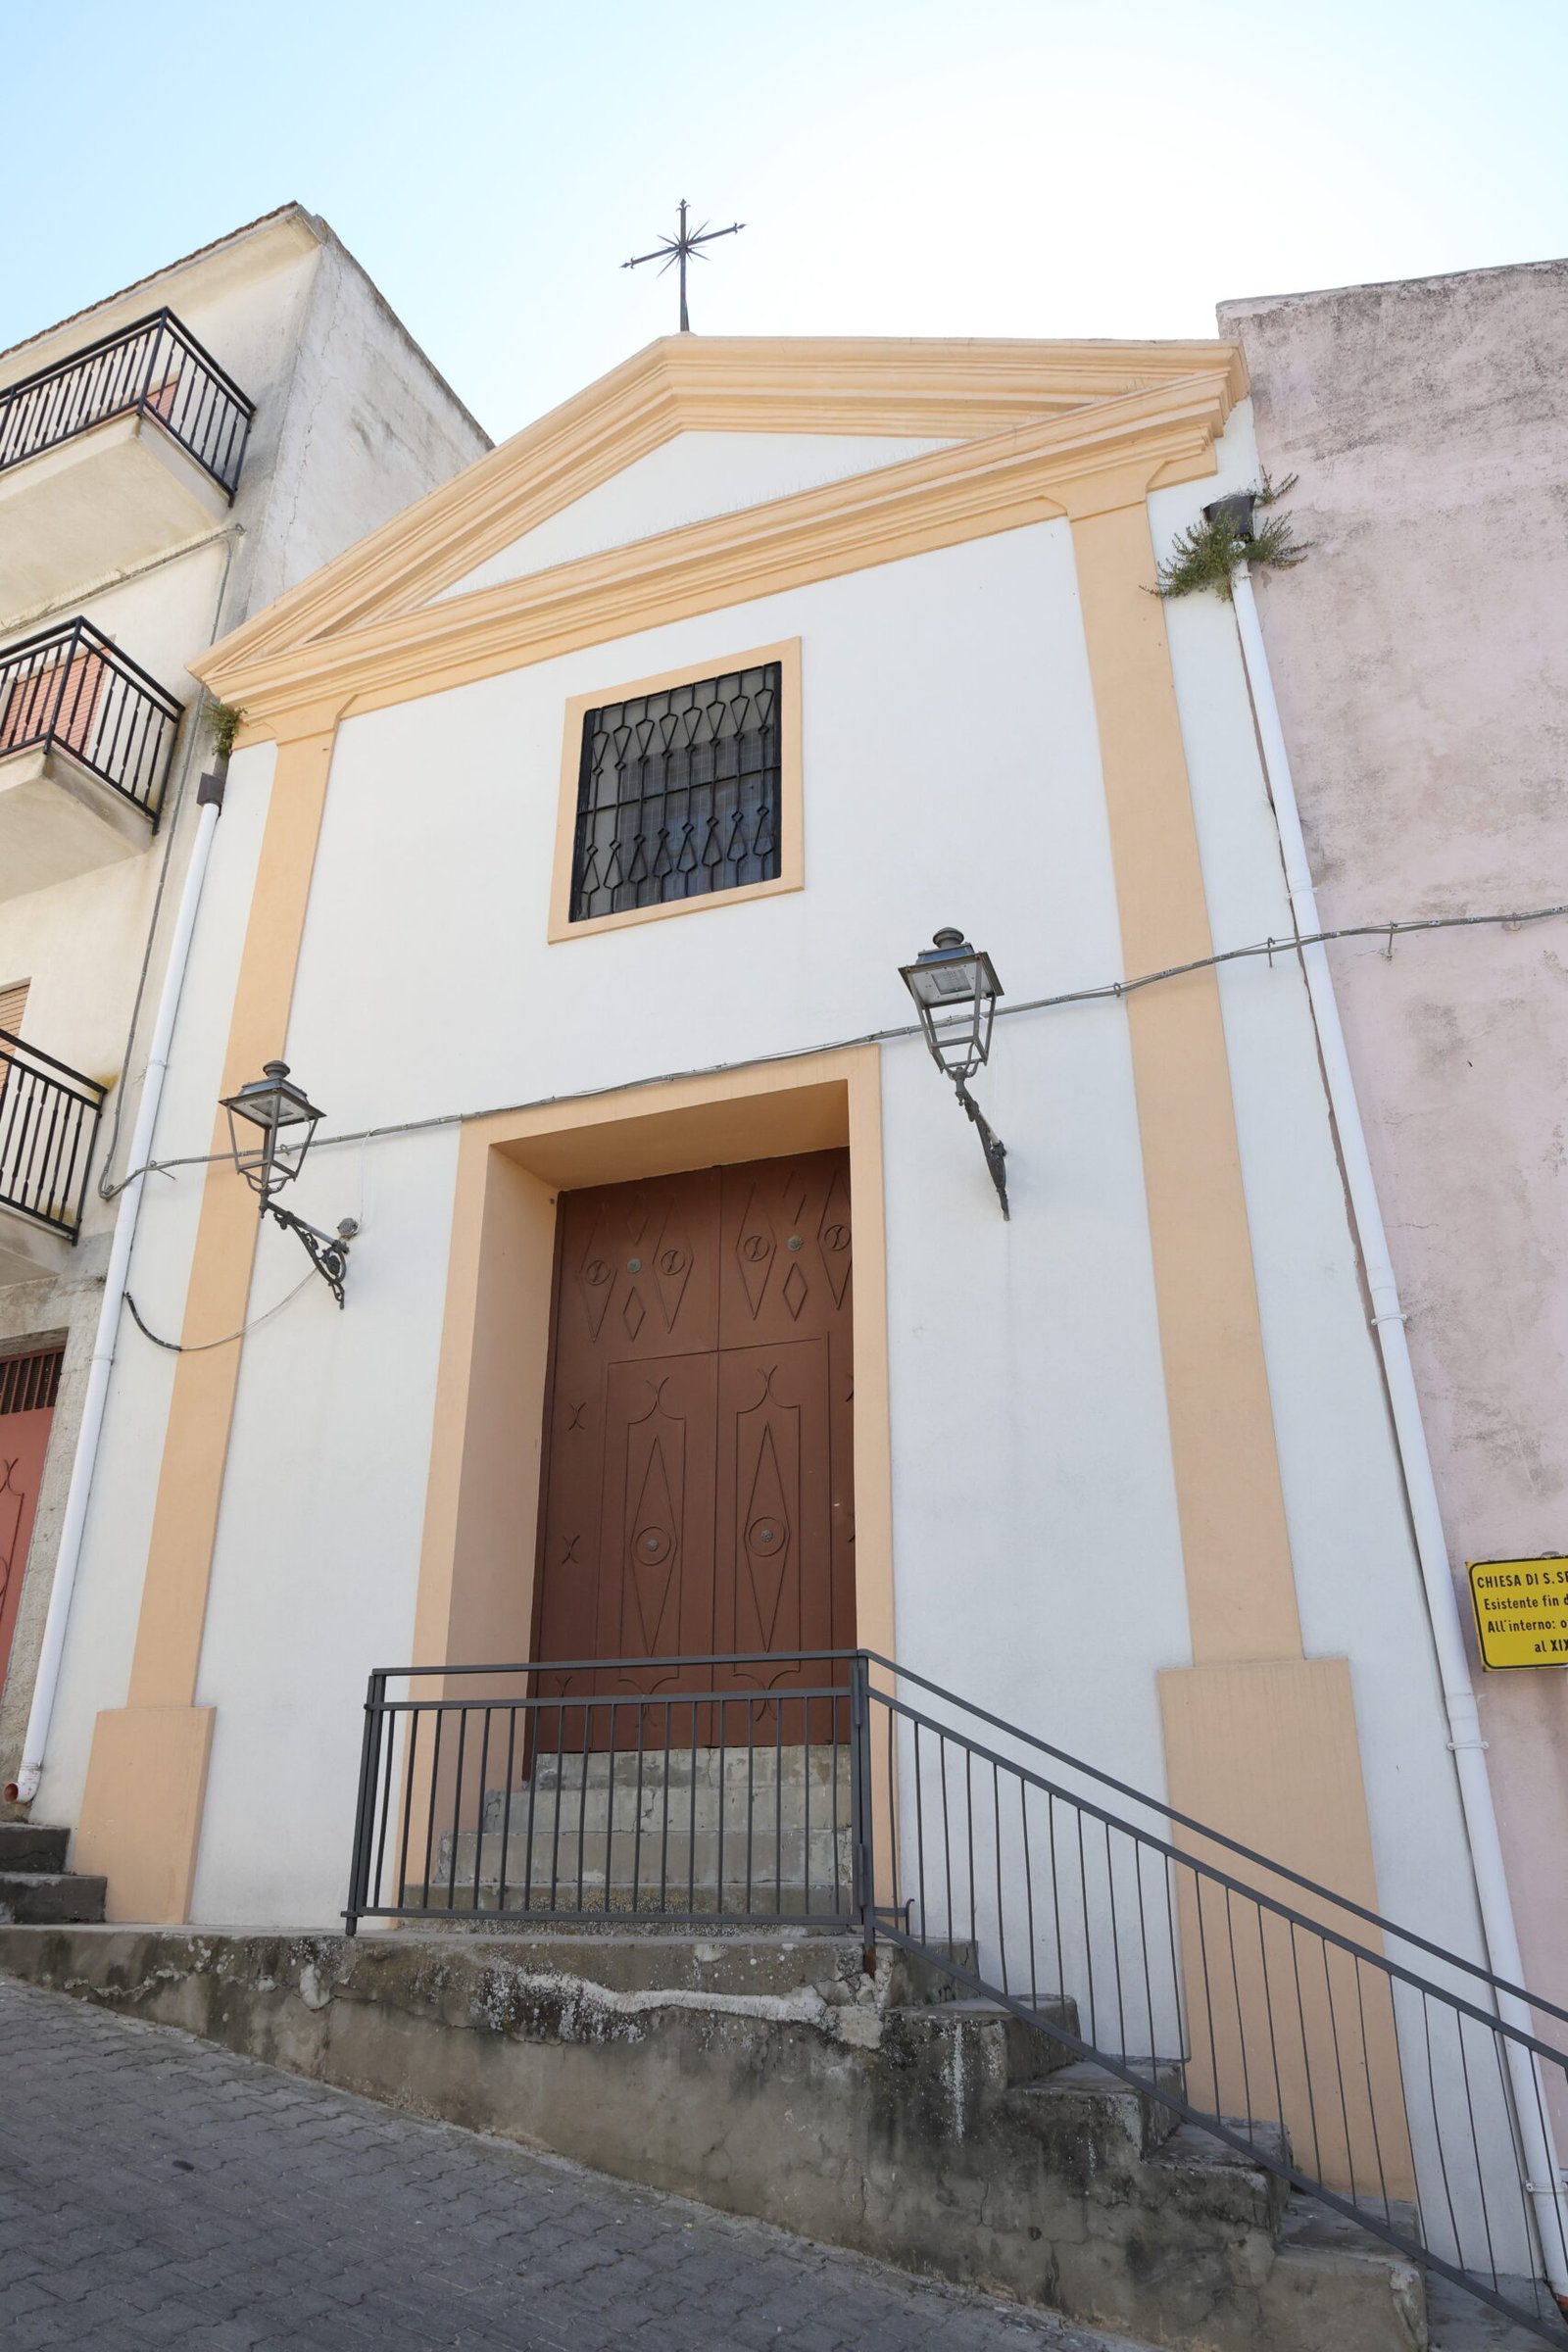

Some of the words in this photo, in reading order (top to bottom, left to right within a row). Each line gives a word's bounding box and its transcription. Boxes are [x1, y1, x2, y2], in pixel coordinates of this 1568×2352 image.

[1477, 1574, 1522, 1588] CHIESA
[1526, 1573, 1539, 1586] DI
[1484, 1596, 1539, 1610] Esistente
[1543, 1594, 1559, 1607] fin
[1534, 1640, 1547, 1653] al
